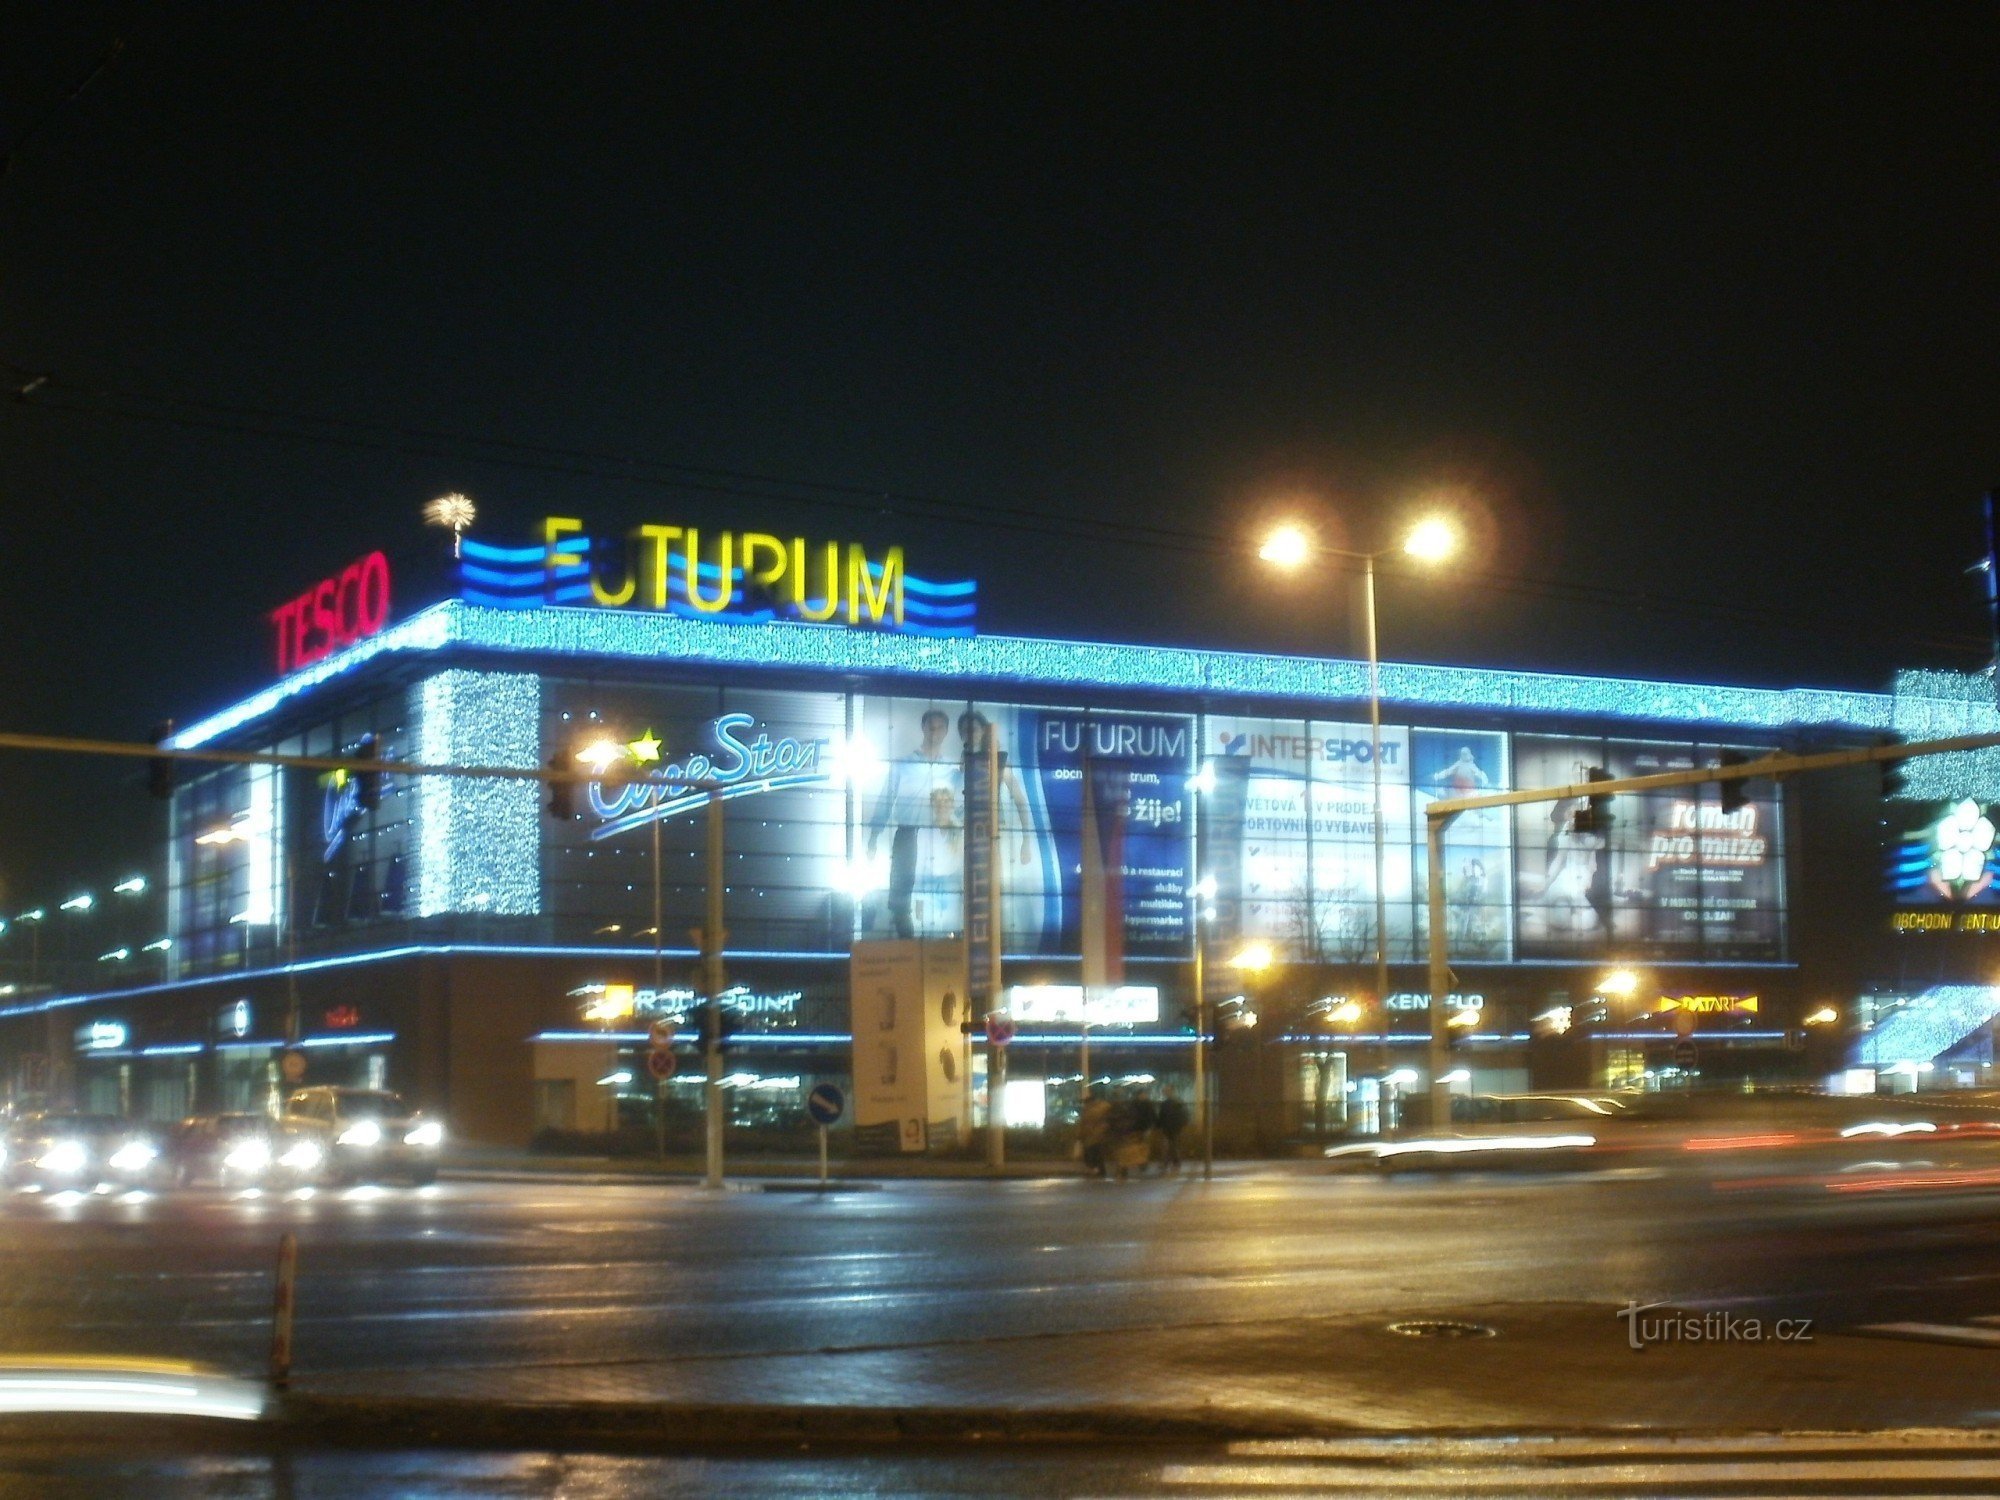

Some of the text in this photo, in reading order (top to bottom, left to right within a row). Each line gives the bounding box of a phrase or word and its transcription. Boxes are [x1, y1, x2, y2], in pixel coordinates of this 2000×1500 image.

[272, 551, 390, 674] TESCO
[1045, 720, 1185, 757] FUURUM
[1250, 732, 1400, 764] INTERSPORT
[1135, 798, 1182, 828] žije!
[1649, 836, 1694, 867] pro
[1960, 912, 2000, 931] CENTRU
